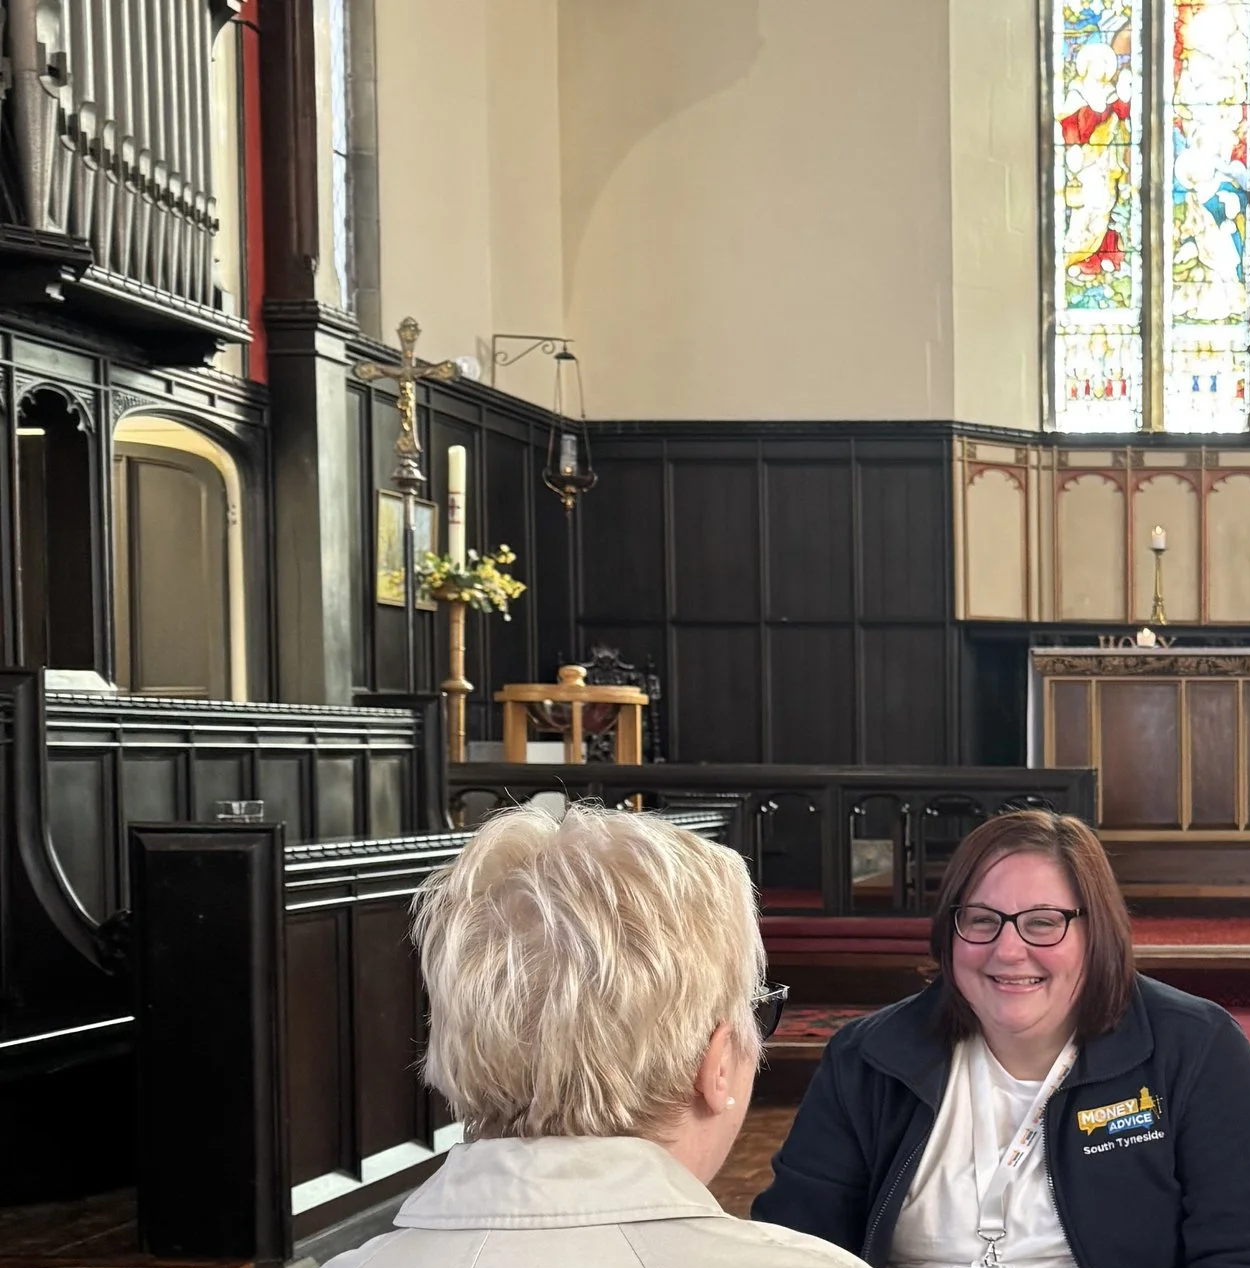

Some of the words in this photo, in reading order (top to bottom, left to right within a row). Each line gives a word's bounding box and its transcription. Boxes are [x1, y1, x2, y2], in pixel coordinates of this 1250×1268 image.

[1081, 1101, 1135, 1124] MONEY
[1109, 1113, 1152, 1131] ADVICE
[1083, 1142, 1115, 1155] South
[1116, 1130, 1165, 1147] Tyneside
